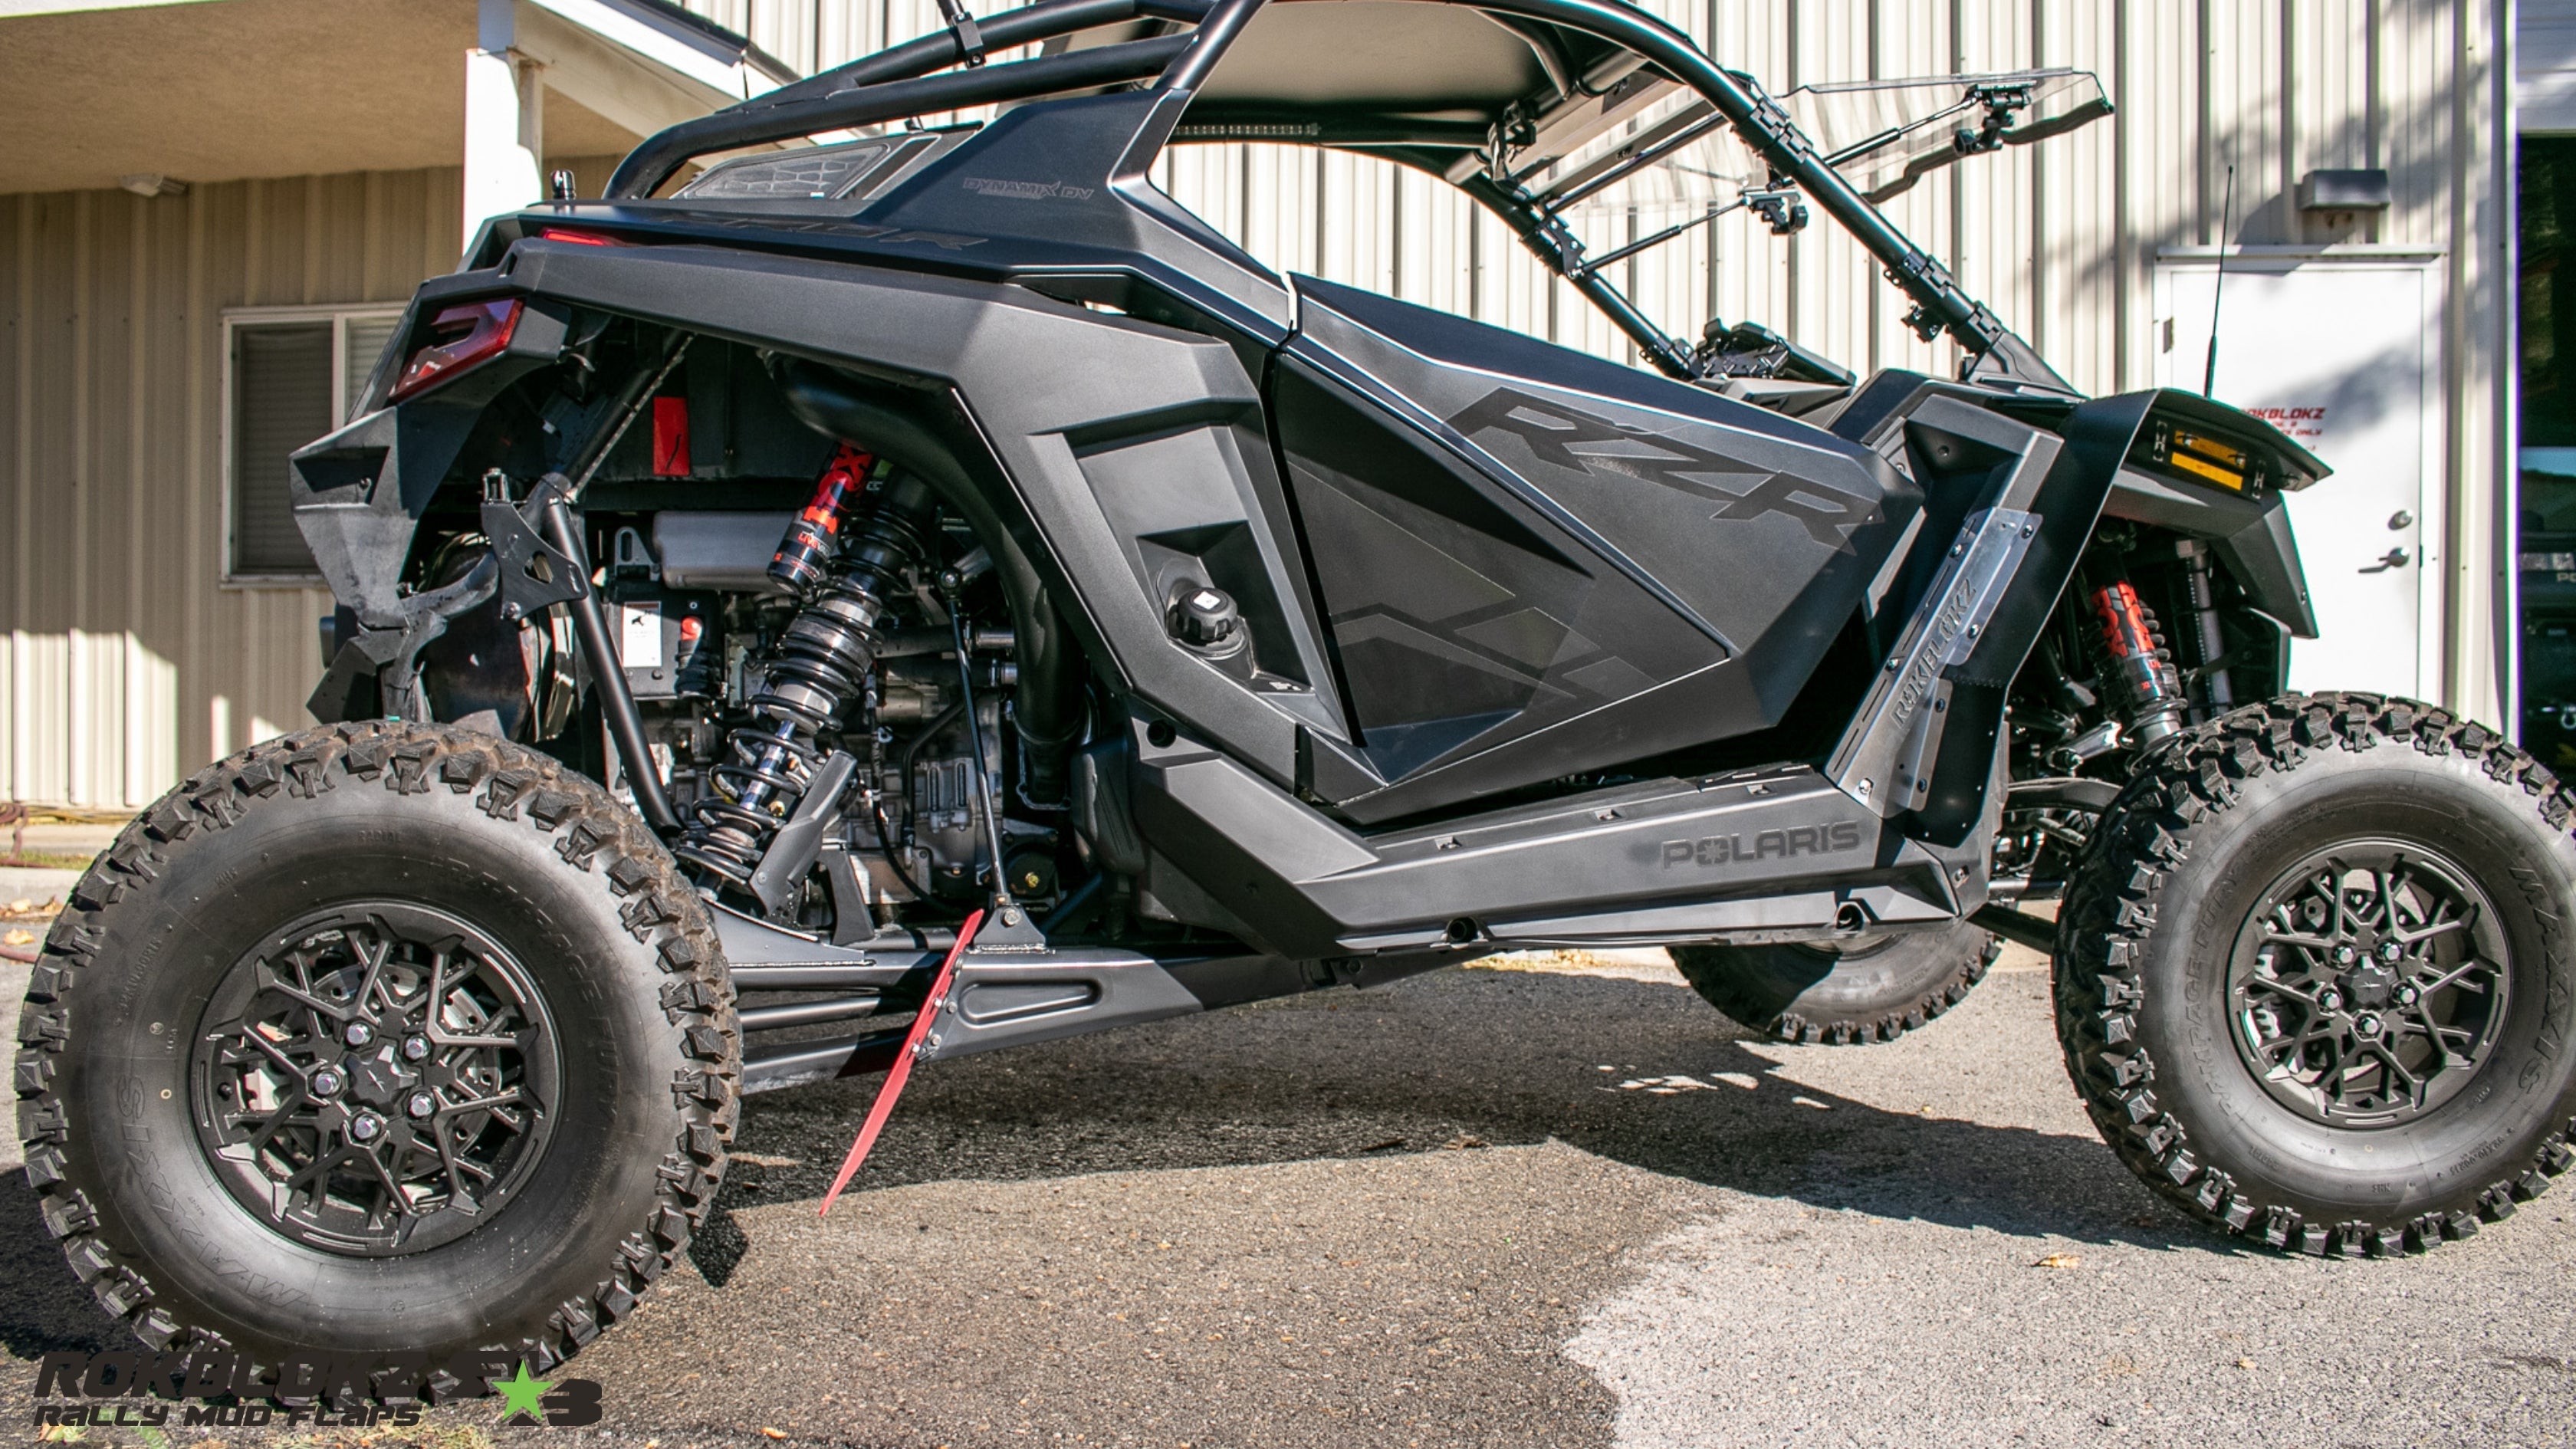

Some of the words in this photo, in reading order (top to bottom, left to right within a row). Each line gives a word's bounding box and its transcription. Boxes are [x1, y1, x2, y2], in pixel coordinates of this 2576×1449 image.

[1442, 386, 1884, 557] RZR
[1662, 820, 1861, 870] POLARIS
[2508, 860, 2568, 1095] MAXXIS
[119, 1076, 307, 1309] MAXXIS
